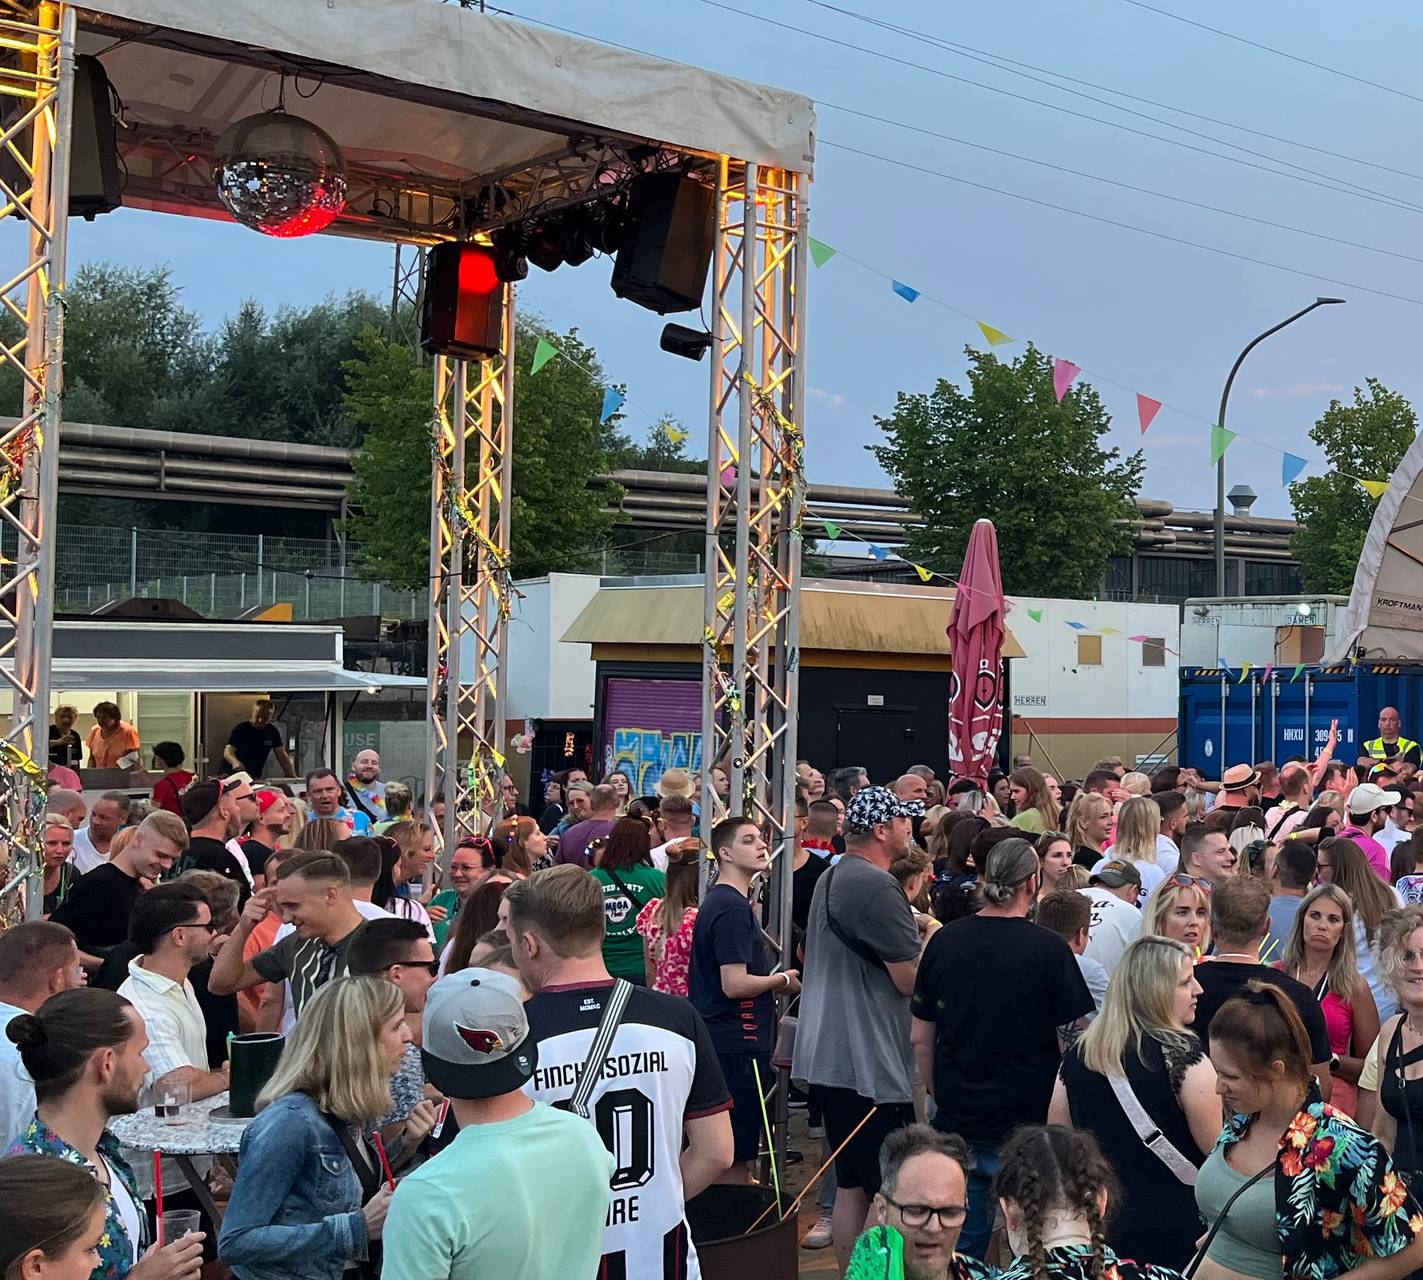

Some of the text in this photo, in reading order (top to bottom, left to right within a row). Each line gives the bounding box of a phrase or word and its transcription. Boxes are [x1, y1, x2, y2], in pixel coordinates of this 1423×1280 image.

[1377, 598, 1423, 612] KROFTMAN
[1286, 616, 1315, 626] DAMEN
[1015, 695, 1047, 706] HERREN
[1283, 728, 1304, 741] HHXU
[1314, 729, 1343, 742] 3095
